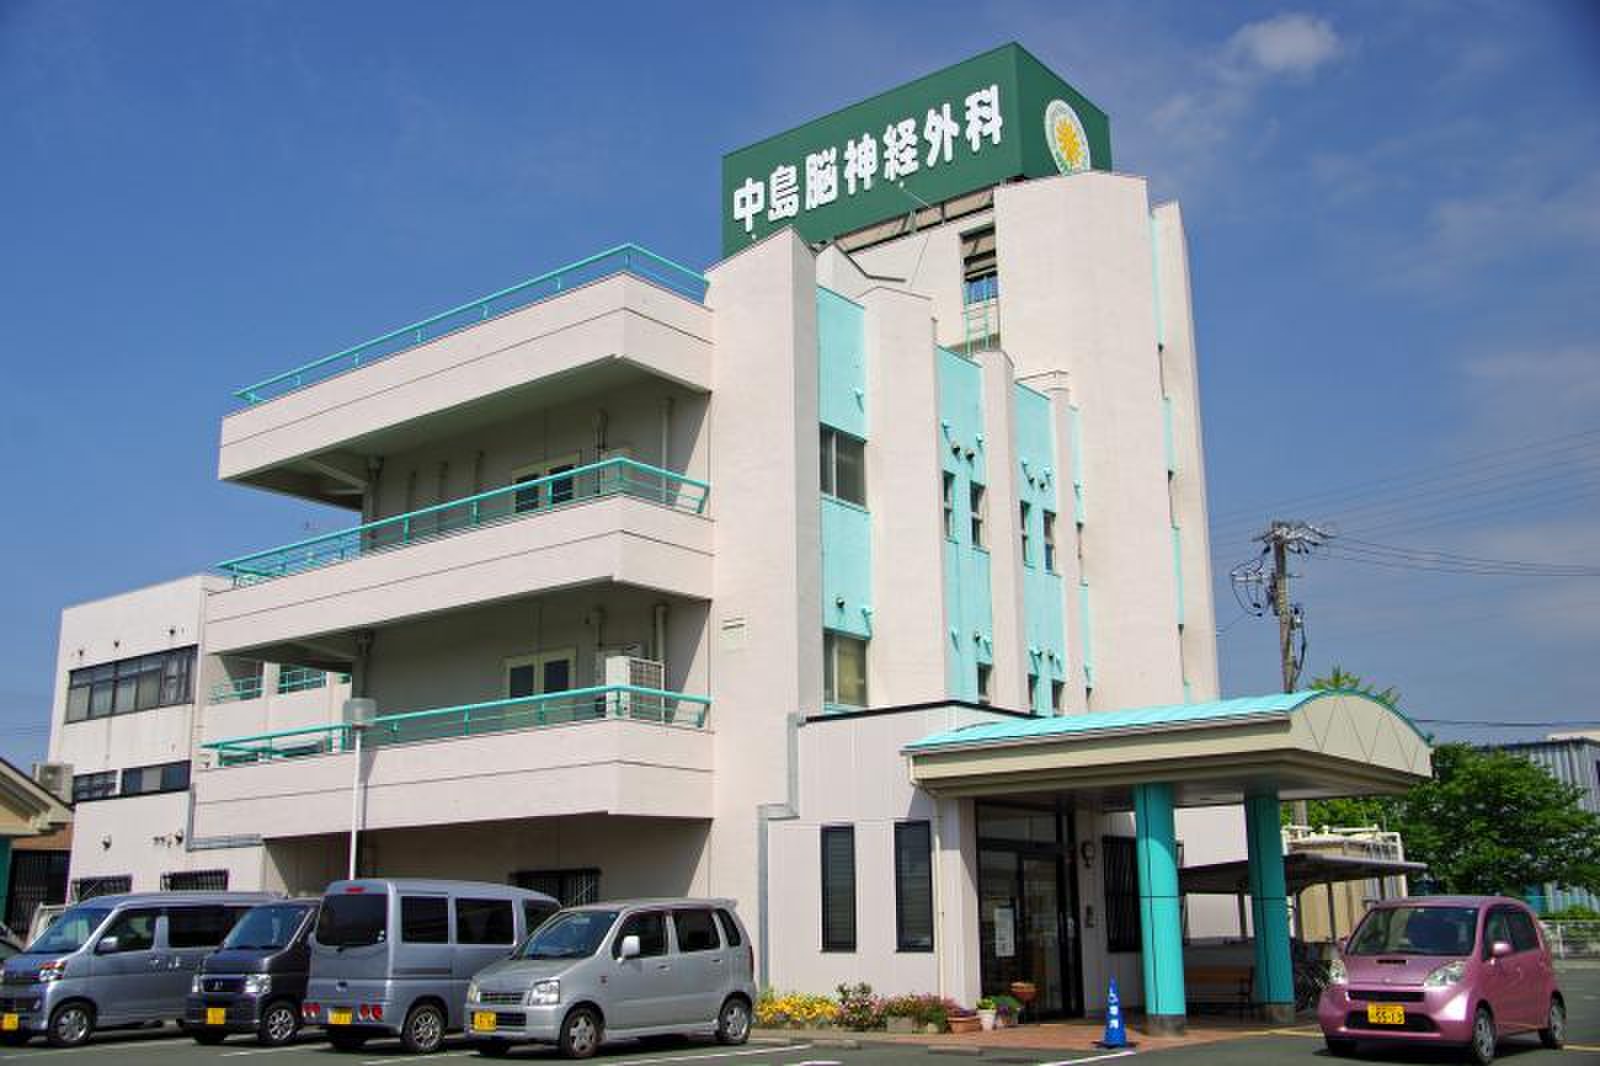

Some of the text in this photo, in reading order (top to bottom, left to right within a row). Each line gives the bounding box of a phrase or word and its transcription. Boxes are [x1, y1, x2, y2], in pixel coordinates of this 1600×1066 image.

[733, 84, 1003, 232] 中島脳神経外科
